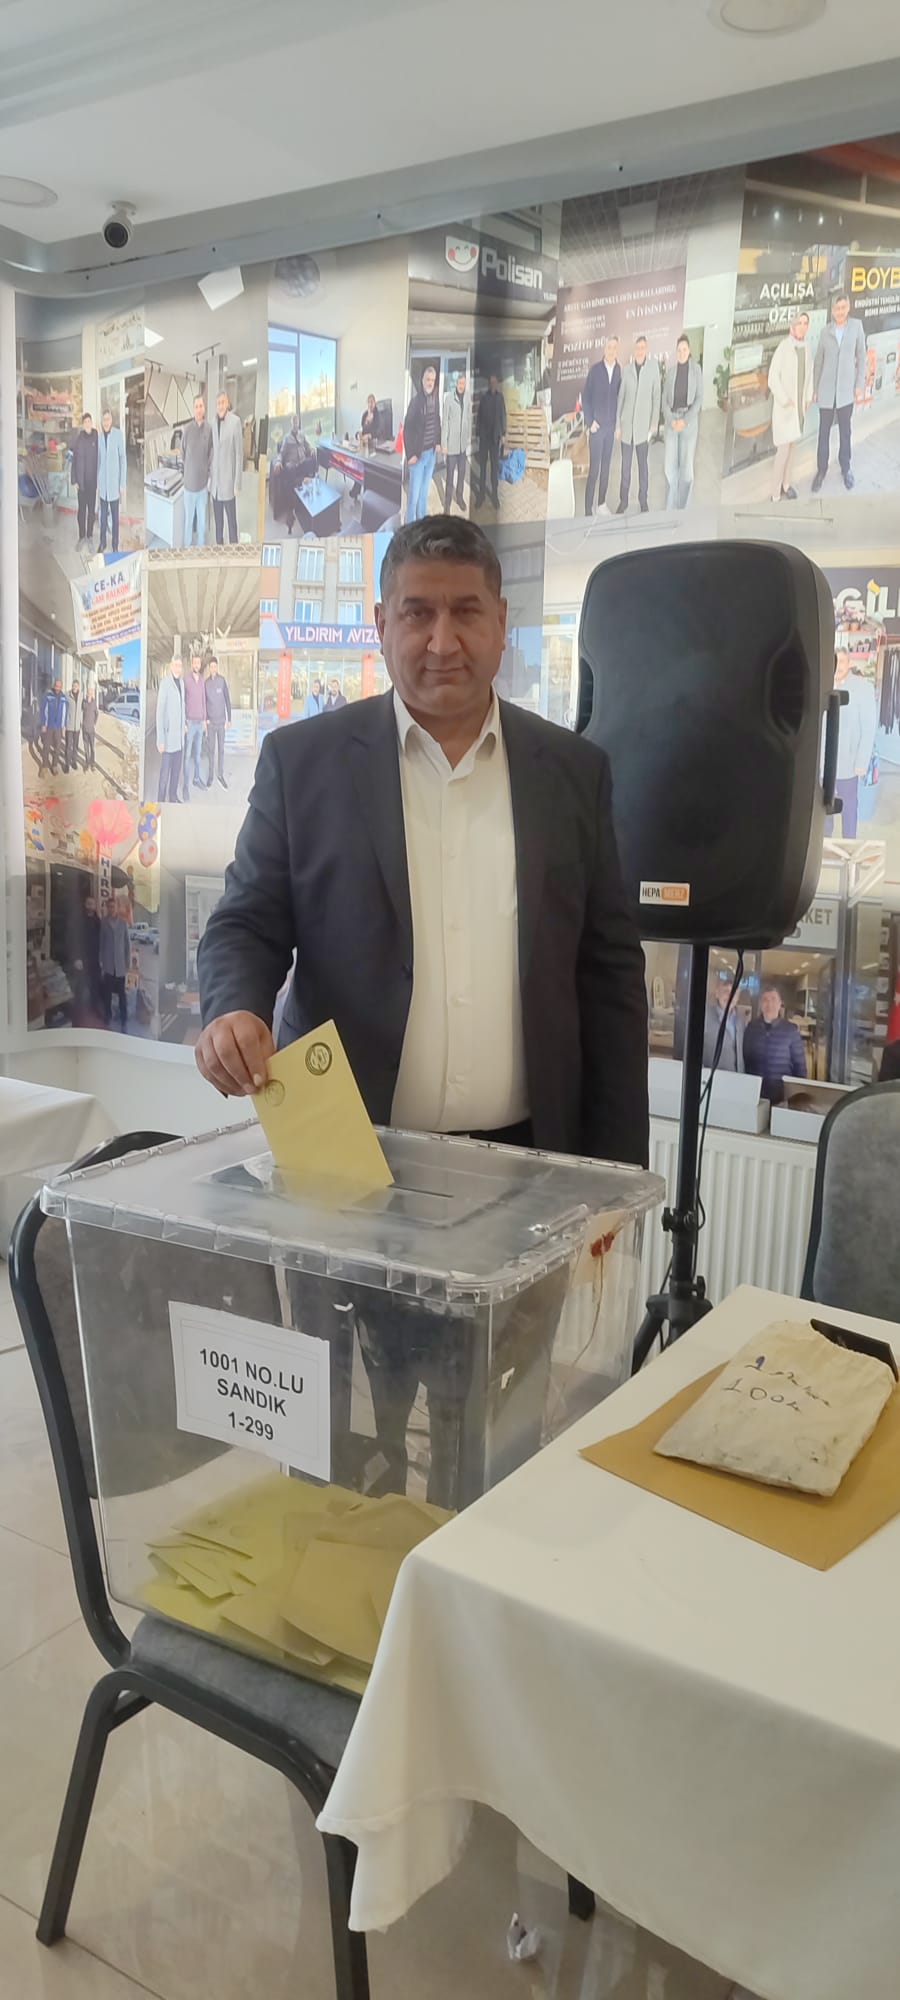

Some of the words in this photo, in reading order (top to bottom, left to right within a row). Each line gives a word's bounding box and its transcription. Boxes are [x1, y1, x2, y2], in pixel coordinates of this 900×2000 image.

[481, 247, 542, 289] Polisan
[759, 282, 814, 301] AÇILIŞA
[94, 571, 124, 593] CE-KA
[285, 626, 343, 643] YILDIRIM
[642, 887, 661, 898] HEPA
[200, 1348, 238, 1374] 1001
[246, 1361, 304, 1394] NO.LU
[217, 1378, 287, 1417] SANDIK
[228, 1411, 274, 1440] 1-299
